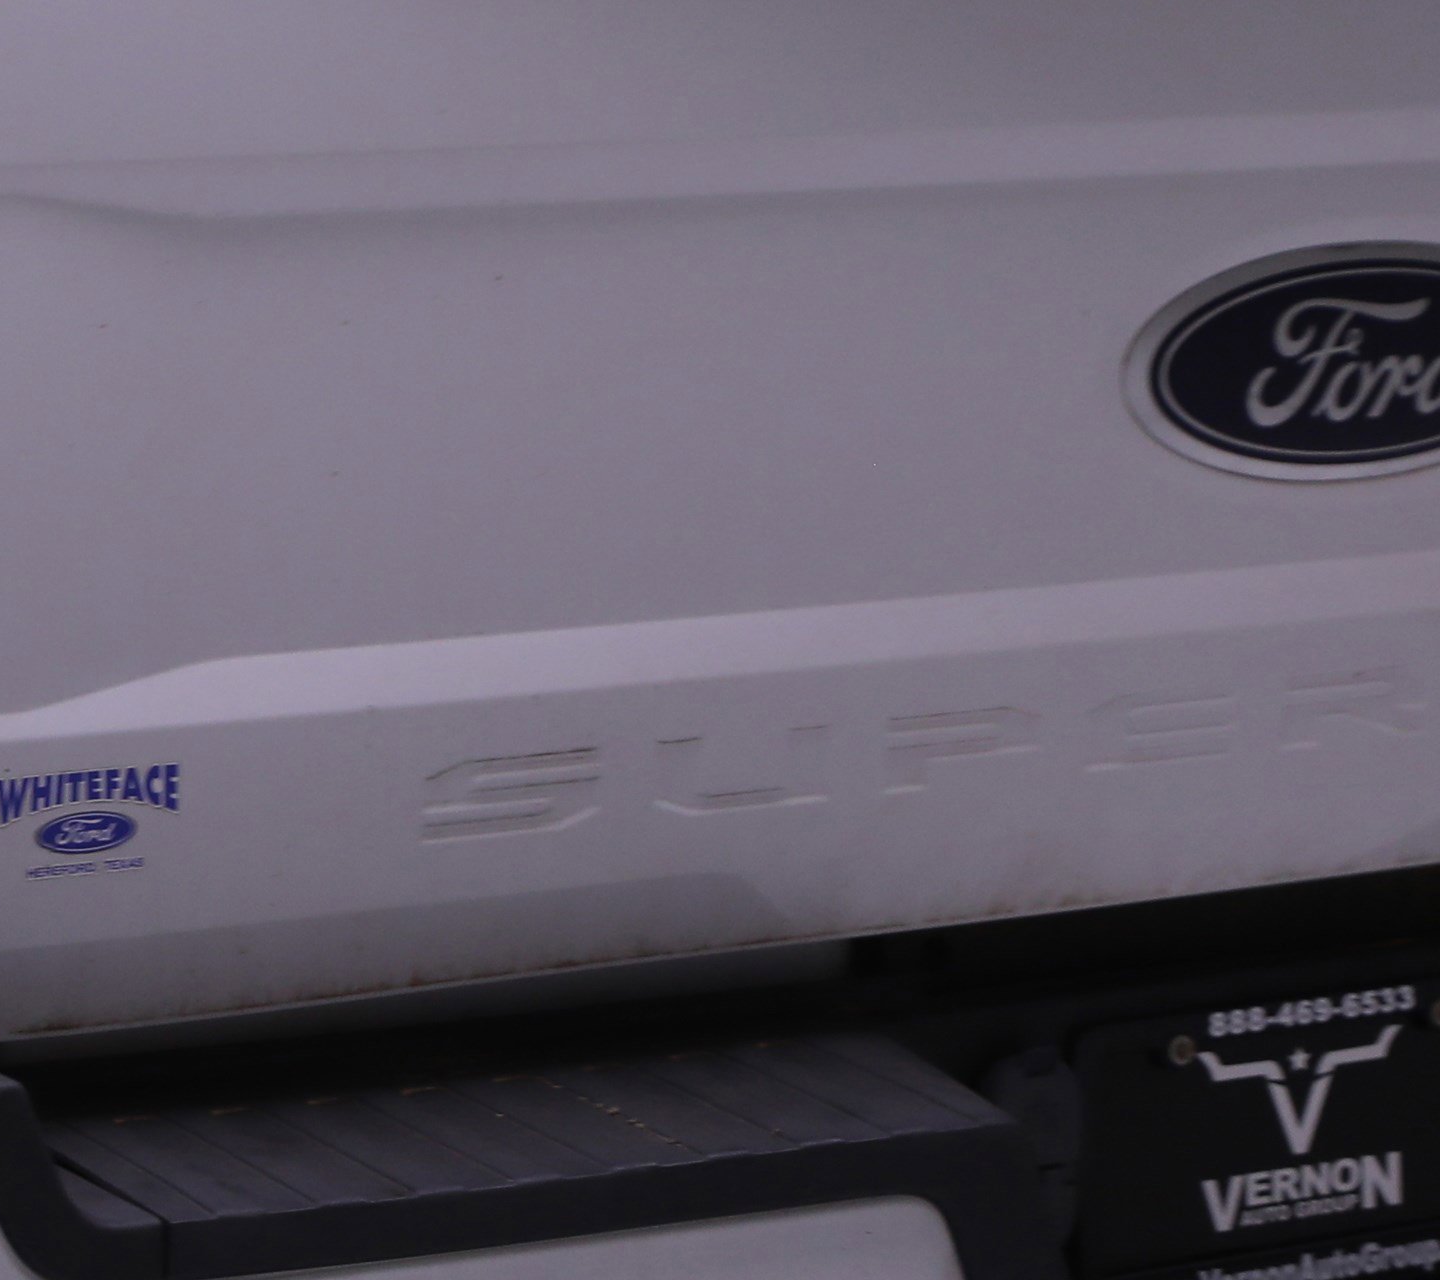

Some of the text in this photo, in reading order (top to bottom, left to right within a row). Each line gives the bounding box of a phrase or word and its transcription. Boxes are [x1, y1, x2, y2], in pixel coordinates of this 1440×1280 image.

[418, 665, 1428, 845] SUPER
[53, 817, 119, 847] Ford
[1201, 1151, 1404, 1233] VERNON
